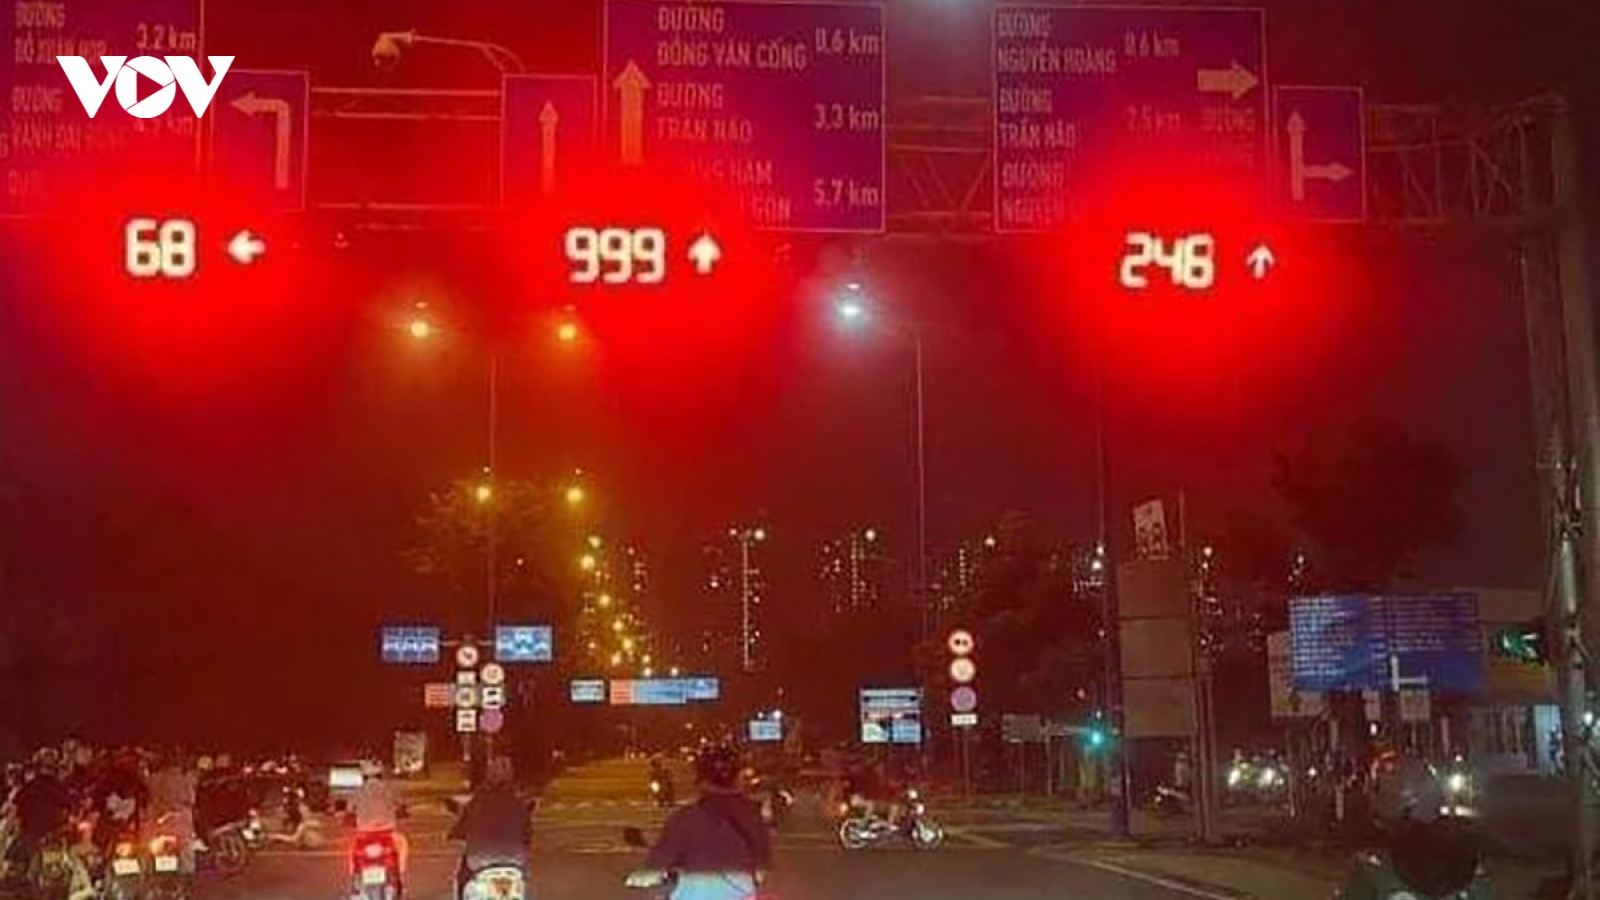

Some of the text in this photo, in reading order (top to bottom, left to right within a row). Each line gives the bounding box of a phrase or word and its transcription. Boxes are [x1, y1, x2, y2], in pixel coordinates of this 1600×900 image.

[168, 25, 196, 51] km
[849, 27, 880, 55] km
[849, 103, 880, 131] km
[849, 180, 879, 207] km
[126, 218, 196, 277] 68
[565, 227, 665, 283] 999
